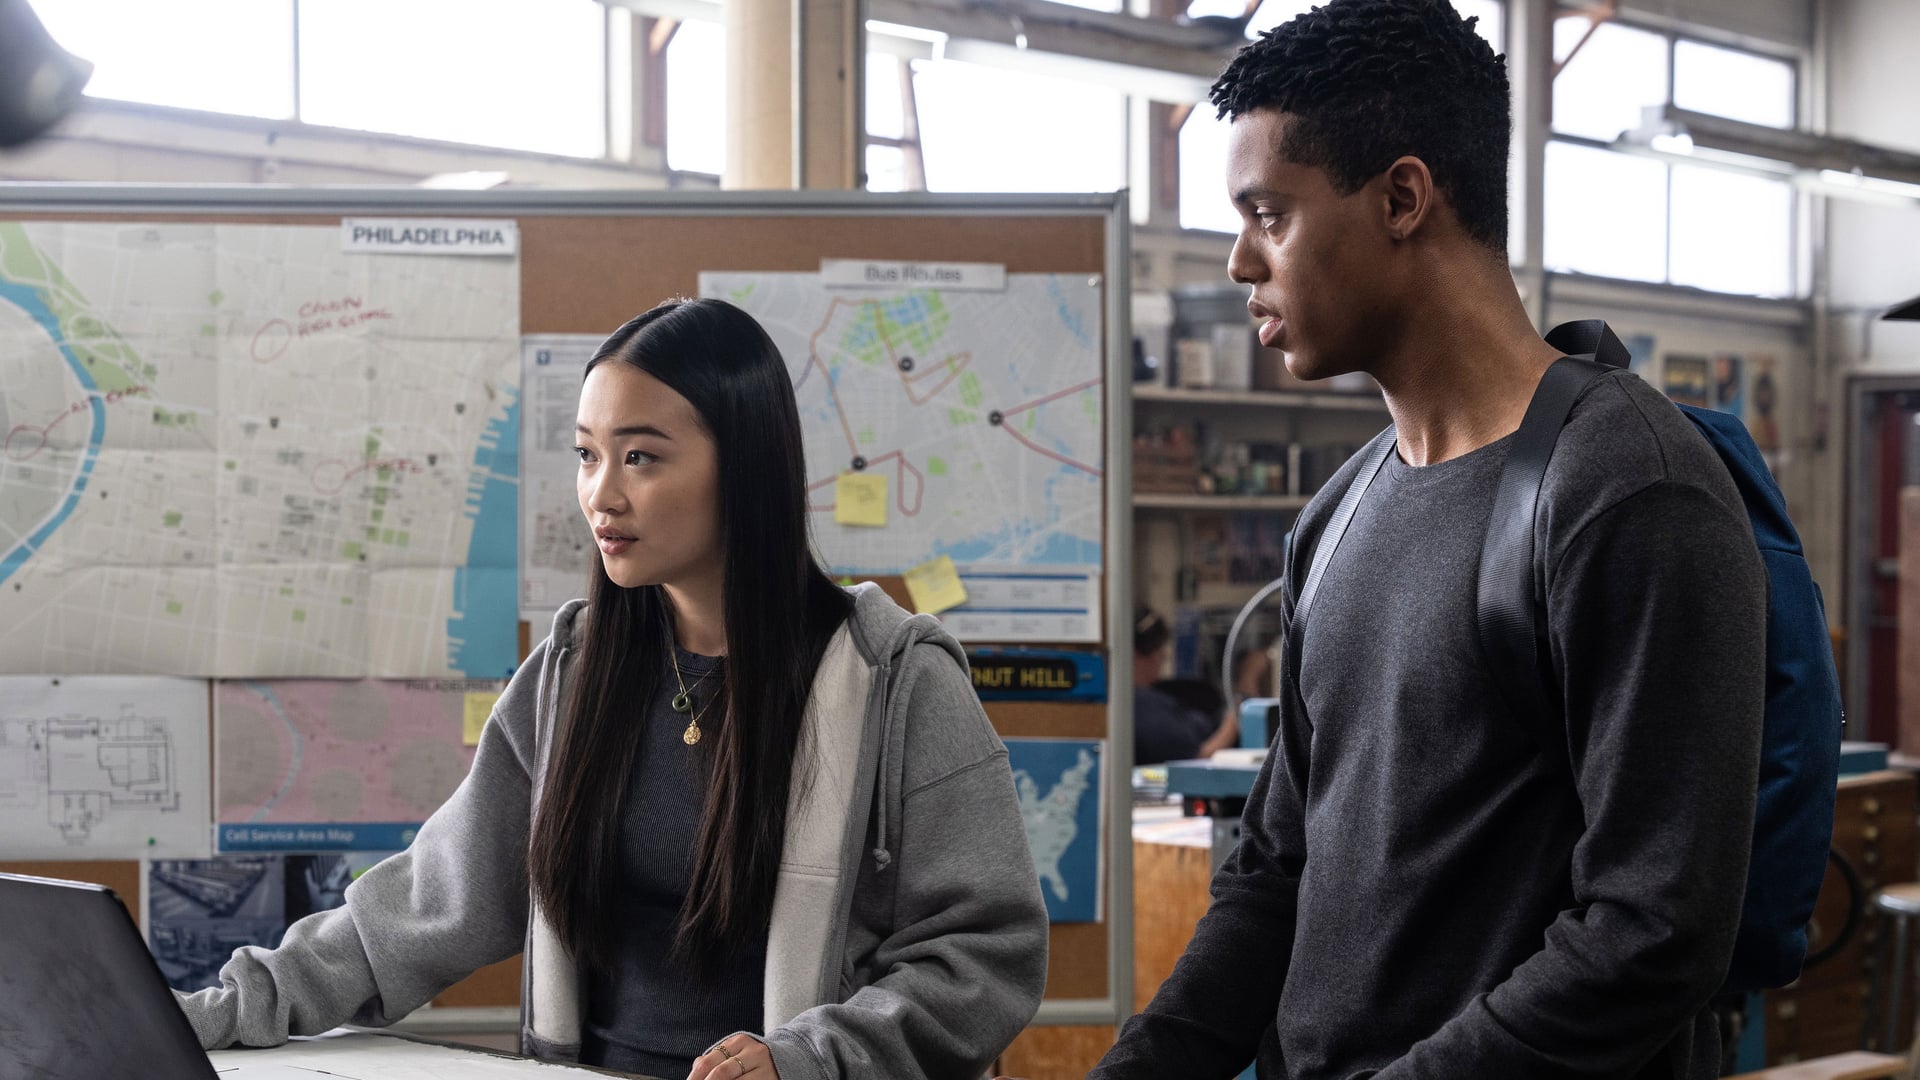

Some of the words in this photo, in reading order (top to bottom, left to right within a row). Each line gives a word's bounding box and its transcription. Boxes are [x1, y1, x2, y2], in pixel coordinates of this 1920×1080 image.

[352, 226, 505, 245] PHILADELPHIA
[864, 264, 898, 281] Bus
[902, 265, 962, 282] Routes
[970, 666, 1014, 688] NUT
[1020, 667, 1072, 688] HILL
[226, 829, 248, 842] Cell
[251, 829, 293, 842] Service
[297, 829, 325, 842] Area
[328, 829, 354, 845] Map
